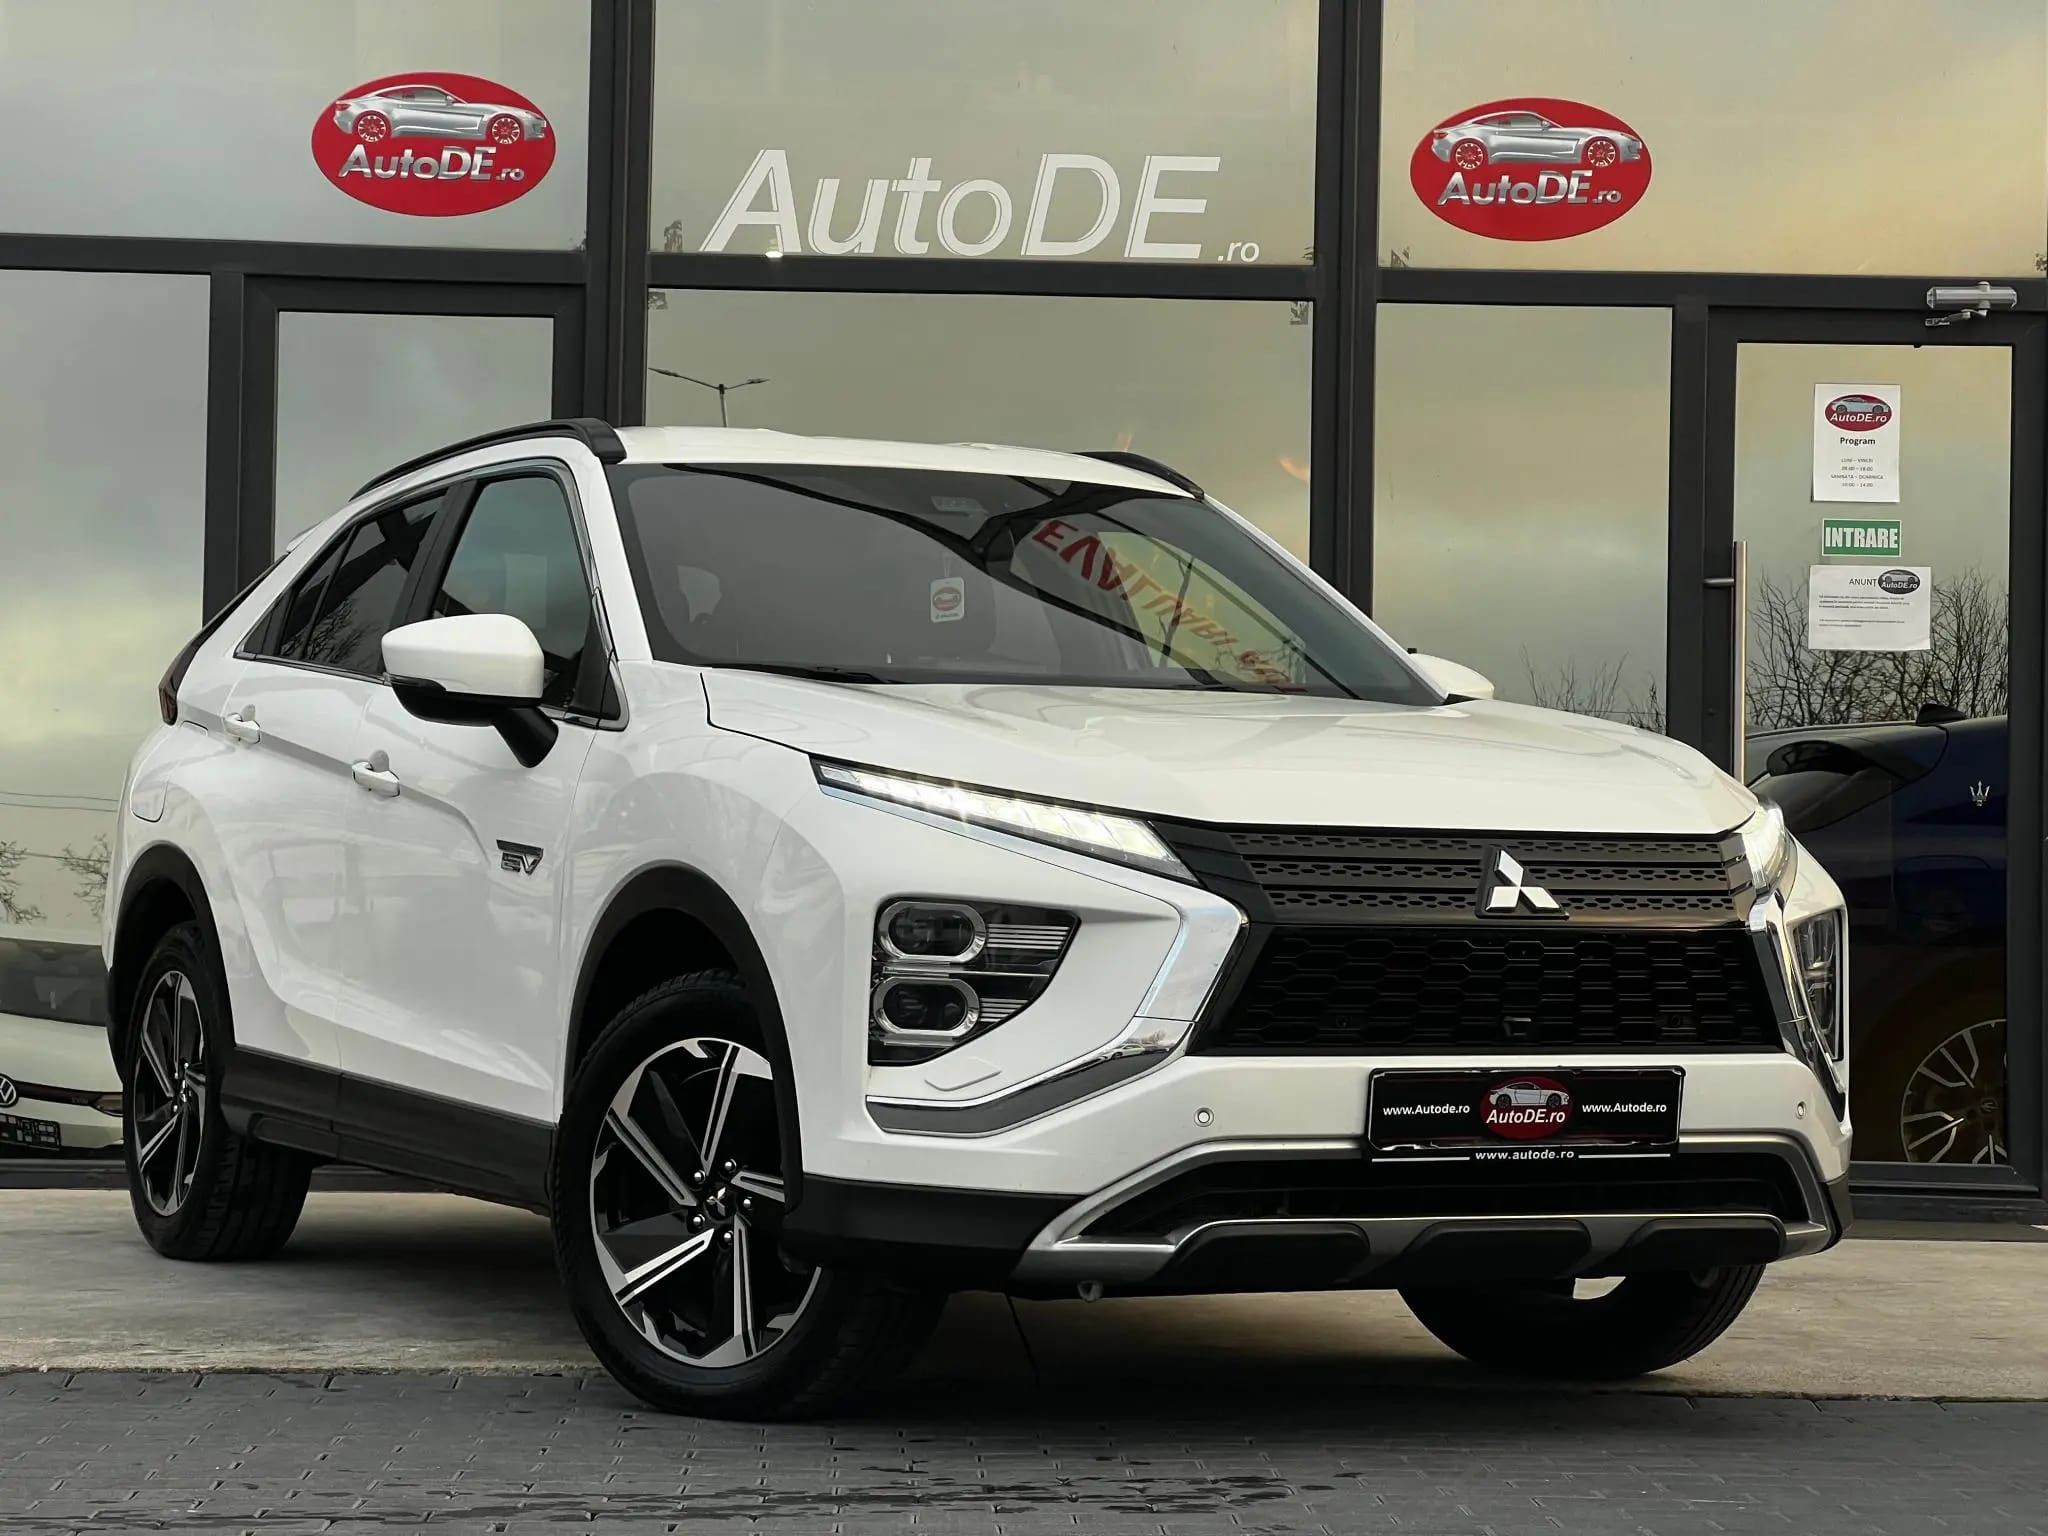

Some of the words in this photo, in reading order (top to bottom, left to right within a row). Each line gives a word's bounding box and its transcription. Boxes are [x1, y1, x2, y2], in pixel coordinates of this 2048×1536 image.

[1830, 413, 1888, 423] AutoDE.ro
[1840, 437, 1876, 446] Program
[1825, 527, 1898, 549] INTRARE
[1881, 581, 1918, 590] AutoDE.ro
[1383, 1103, 1470, 1116] www.Autode.ro
[1582, 1102, 1667, 1113] www.Autode.ro
[1486, 1109, 1566, 1124] AutoDE.ro
[1475, 1150, 1574, 1160] www.autode.ro
